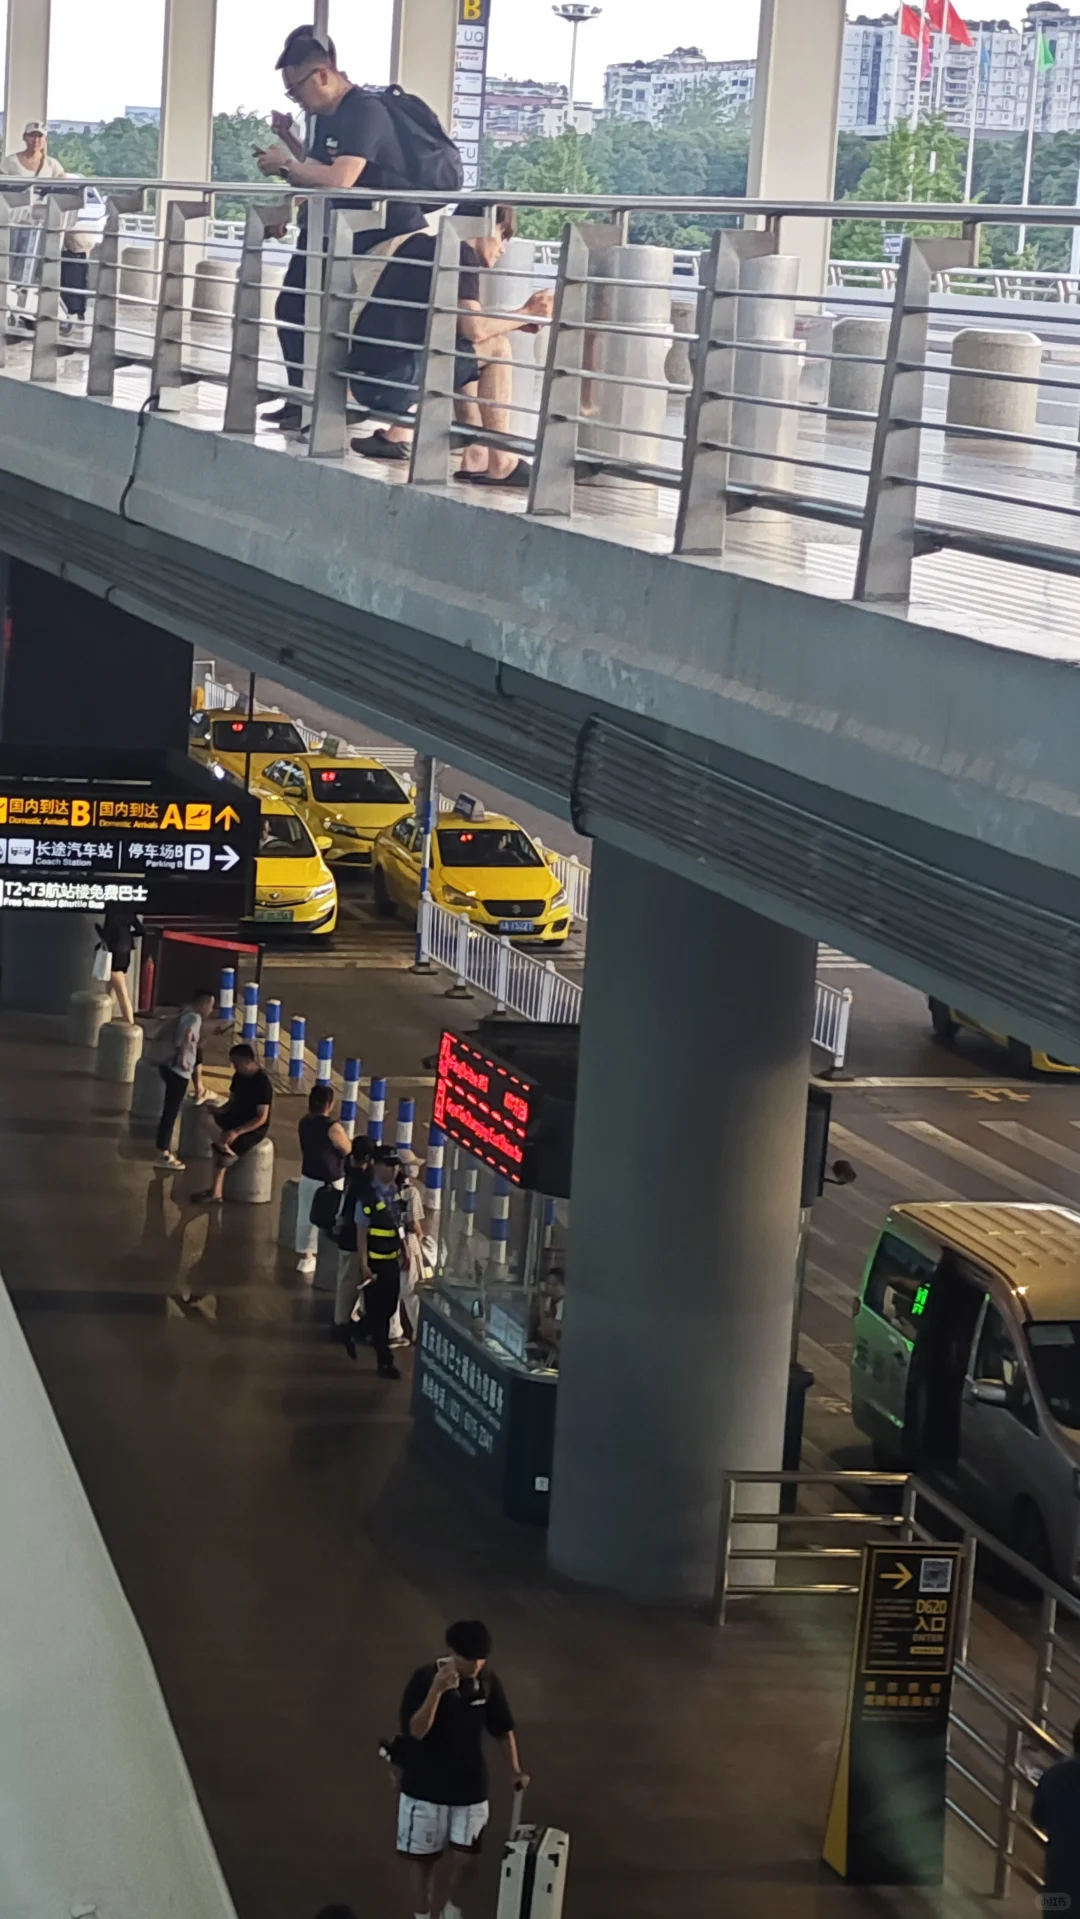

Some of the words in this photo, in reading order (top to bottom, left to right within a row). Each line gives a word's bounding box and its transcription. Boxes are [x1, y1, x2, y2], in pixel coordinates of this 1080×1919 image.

[463, 0, 481, 20] B
[9, 798, 69, 815] 国内到达
[71, 800, 91, 826] B
[99, 801, 159, 818] 国内到达
[159, 803, 184, 830] A
[35, 840, 114, 858] 长途汽车站
[128, 843, 184, 859] 停车场B
[35, 857, 61, 866] Coach
[62, 858, 92, 867] Station
[146, 860, 175, 869] Parking
[3, 897, 22, 907] Free
[23, 898, 57, 908] Terminal
[58, 899, 87, 909] Shuttle
[914, 1616, 946, 1632] 入口
